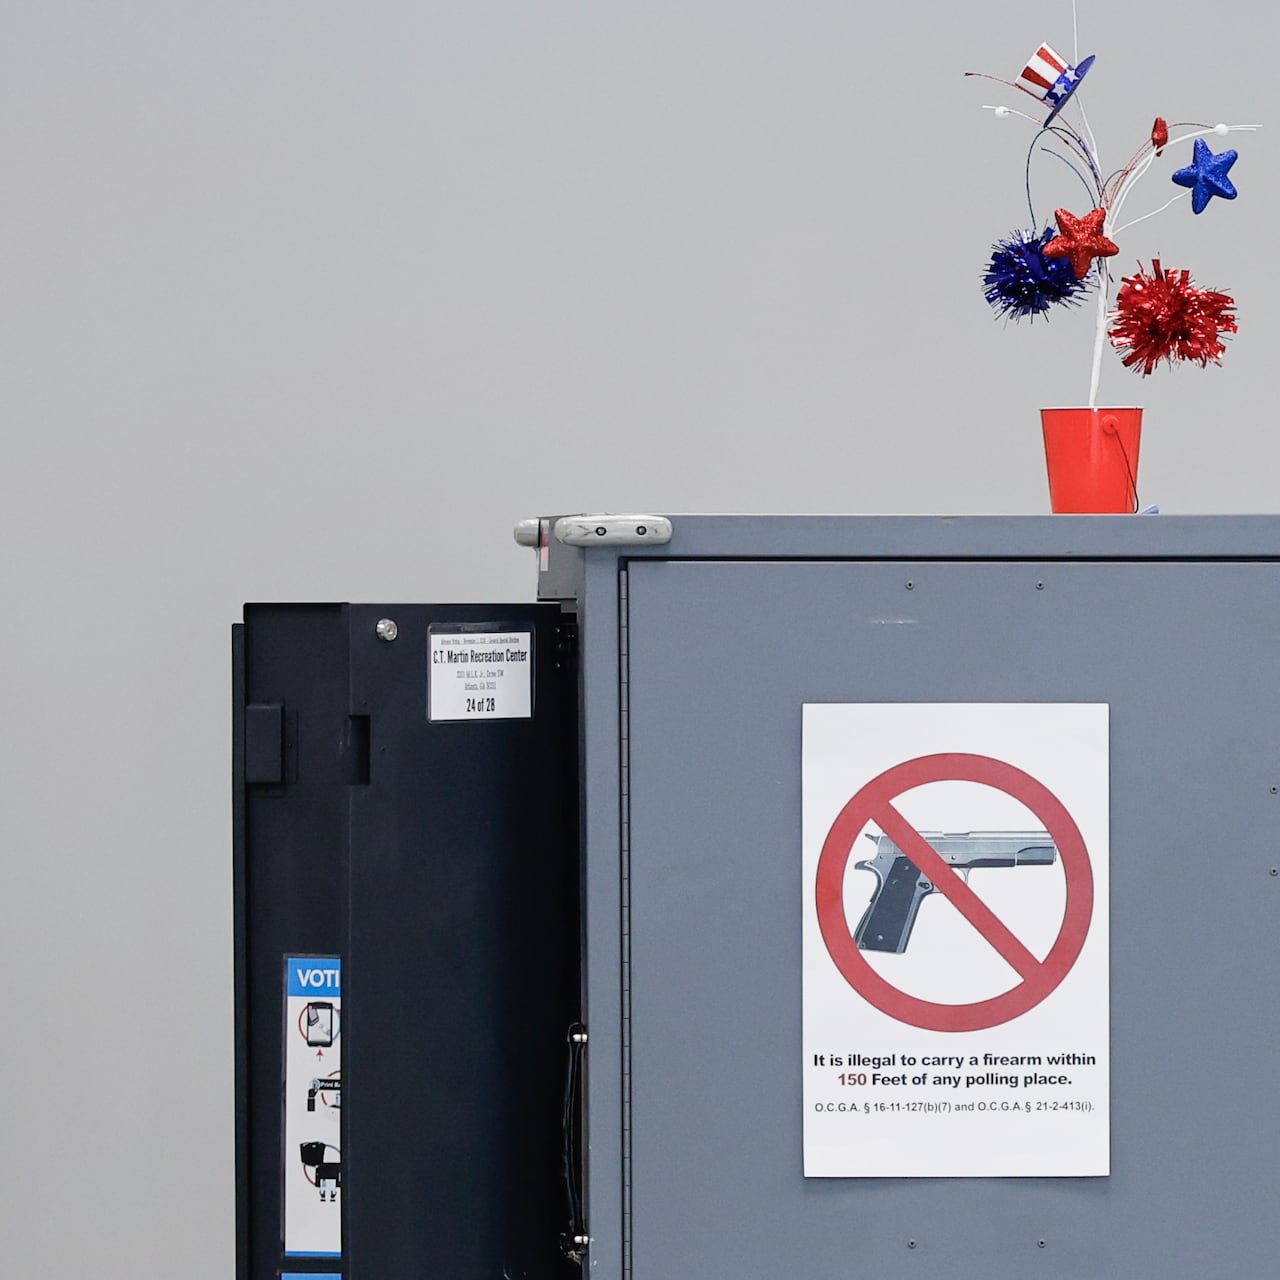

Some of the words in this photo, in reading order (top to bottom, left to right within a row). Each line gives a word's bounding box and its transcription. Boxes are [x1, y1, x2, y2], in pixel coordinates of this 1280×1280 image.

[447, 650, 468, 663] Martin
[471, 649, 504, 663] Recreation
[506, 649, 527, 662] Center
[467, 698, 475, 712] 24
[477, 698, 484, 711] of
[486, 698, 495, 711] 28
[814, 1054, 825, 1066] It
[830, 1054, 843, 1066] is
[848, 1054, 896, 1069] illegal
[900, 1055, 917, 1066] to
[921, 1057, 964, 1069] carry
[969, 1057, 979, 1066] a
[983, 1053, 1042, 1065] firearm
[1046, 1053, 1096, 1065] within
[838, 1073, 867, 1086] 150
[872, 1073, 907, 1085] Feet
[911, 1073, 928, 1085] of
[932, 1076, 961, 1088] any
[966, 1073, 1019, 1088] polling
[1024, 1073, 1072, 1088] place.
[813, 1102, 860, 1113] O.C.G.A.
[862, 1101, 871, 1115] §
[873, 1101, 951, 1114] 16-11-127(b)(7)
[953, 1101, 975, 1112] and
[976, 1101, 1023, 1112] O.C.G.A.
[1024, 1101, 1032, 1114] §
[1035, 1100, 1094, 1113] 21-2-413(i).
